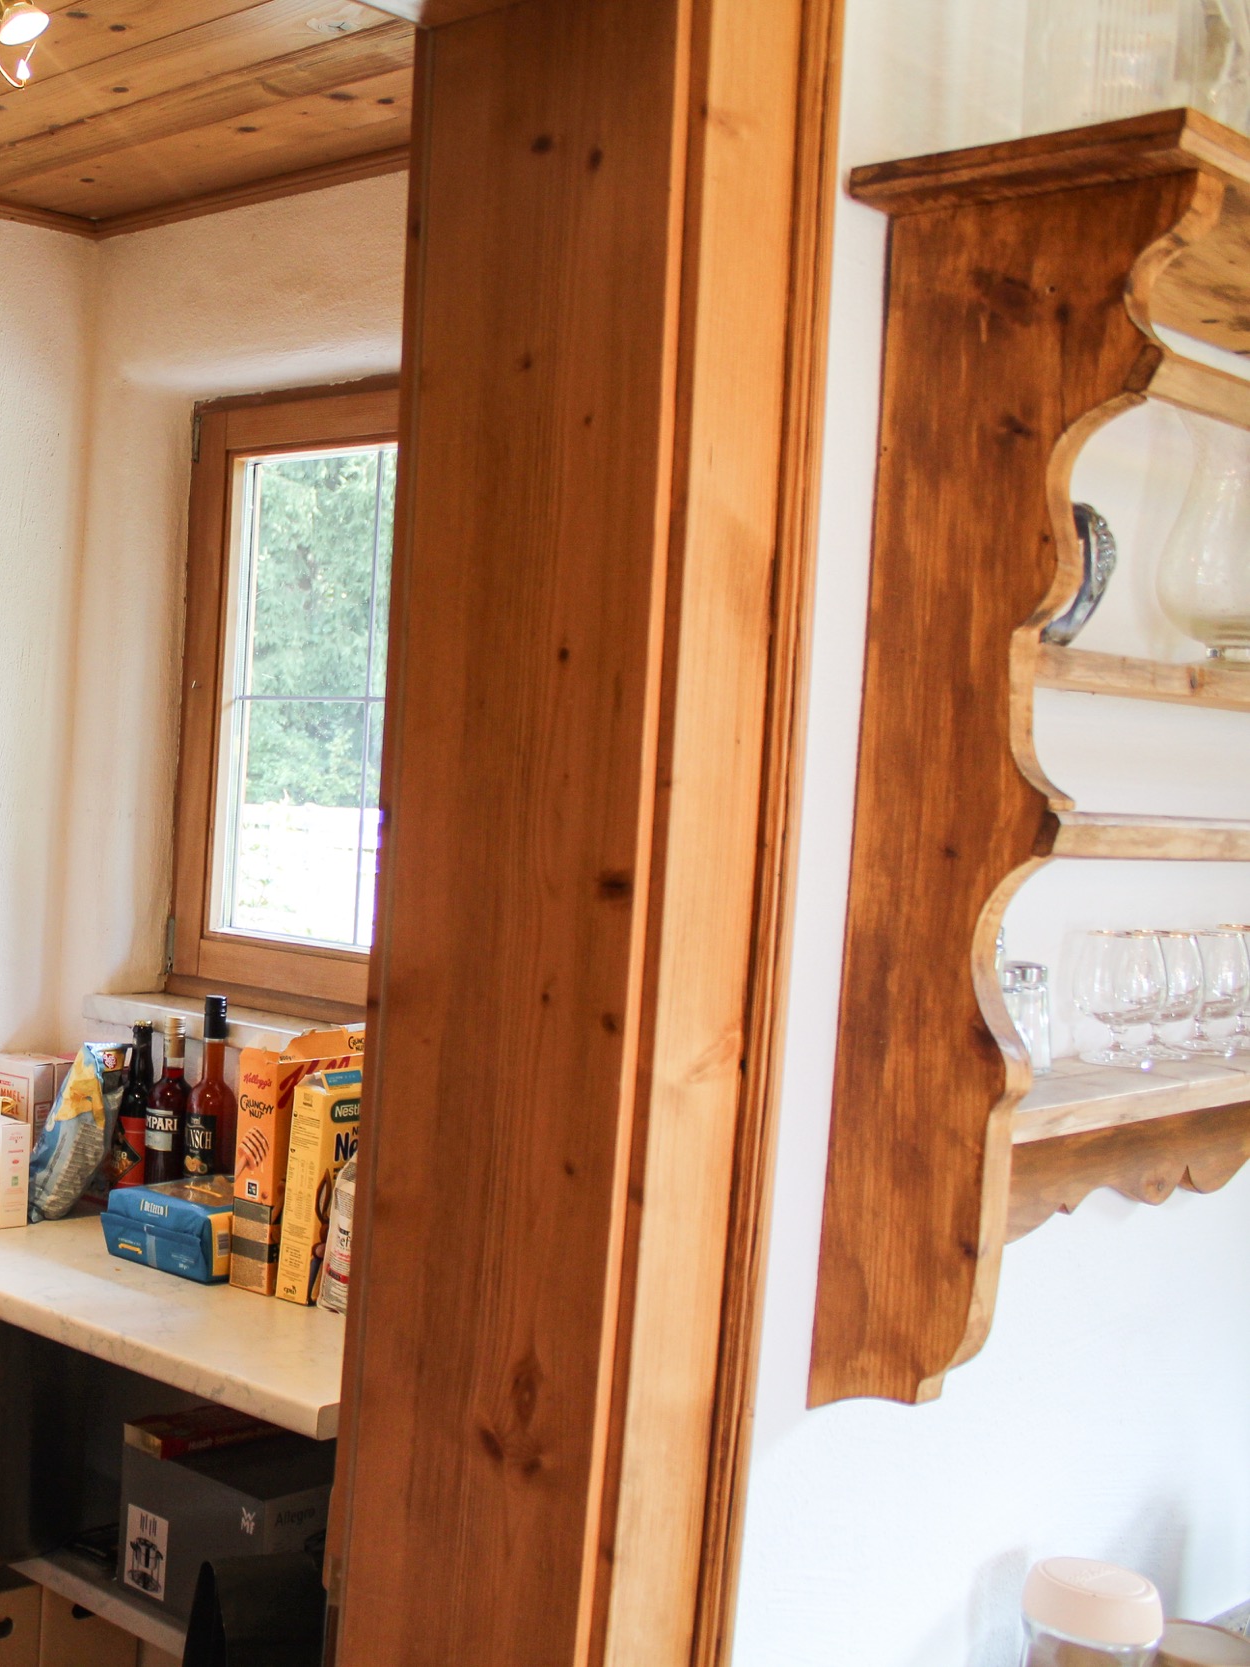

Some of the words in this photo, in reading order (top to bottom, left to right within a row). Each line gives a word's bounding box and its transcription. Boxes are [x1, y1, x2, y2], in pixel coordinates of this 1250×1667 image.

[243, 1072, 272, 1090] Kellogg's
[240, 1094, 275, 1115] CRUNCHY
[334, 1103, 359, 1118] Nestl
[249, 1109, 265, 1120] NUT
[145, 1116, 178, 1132] MPARI
[189, 1129, 213, 1150] NSCH
[275, 1506, 316, 1528] Allegro
